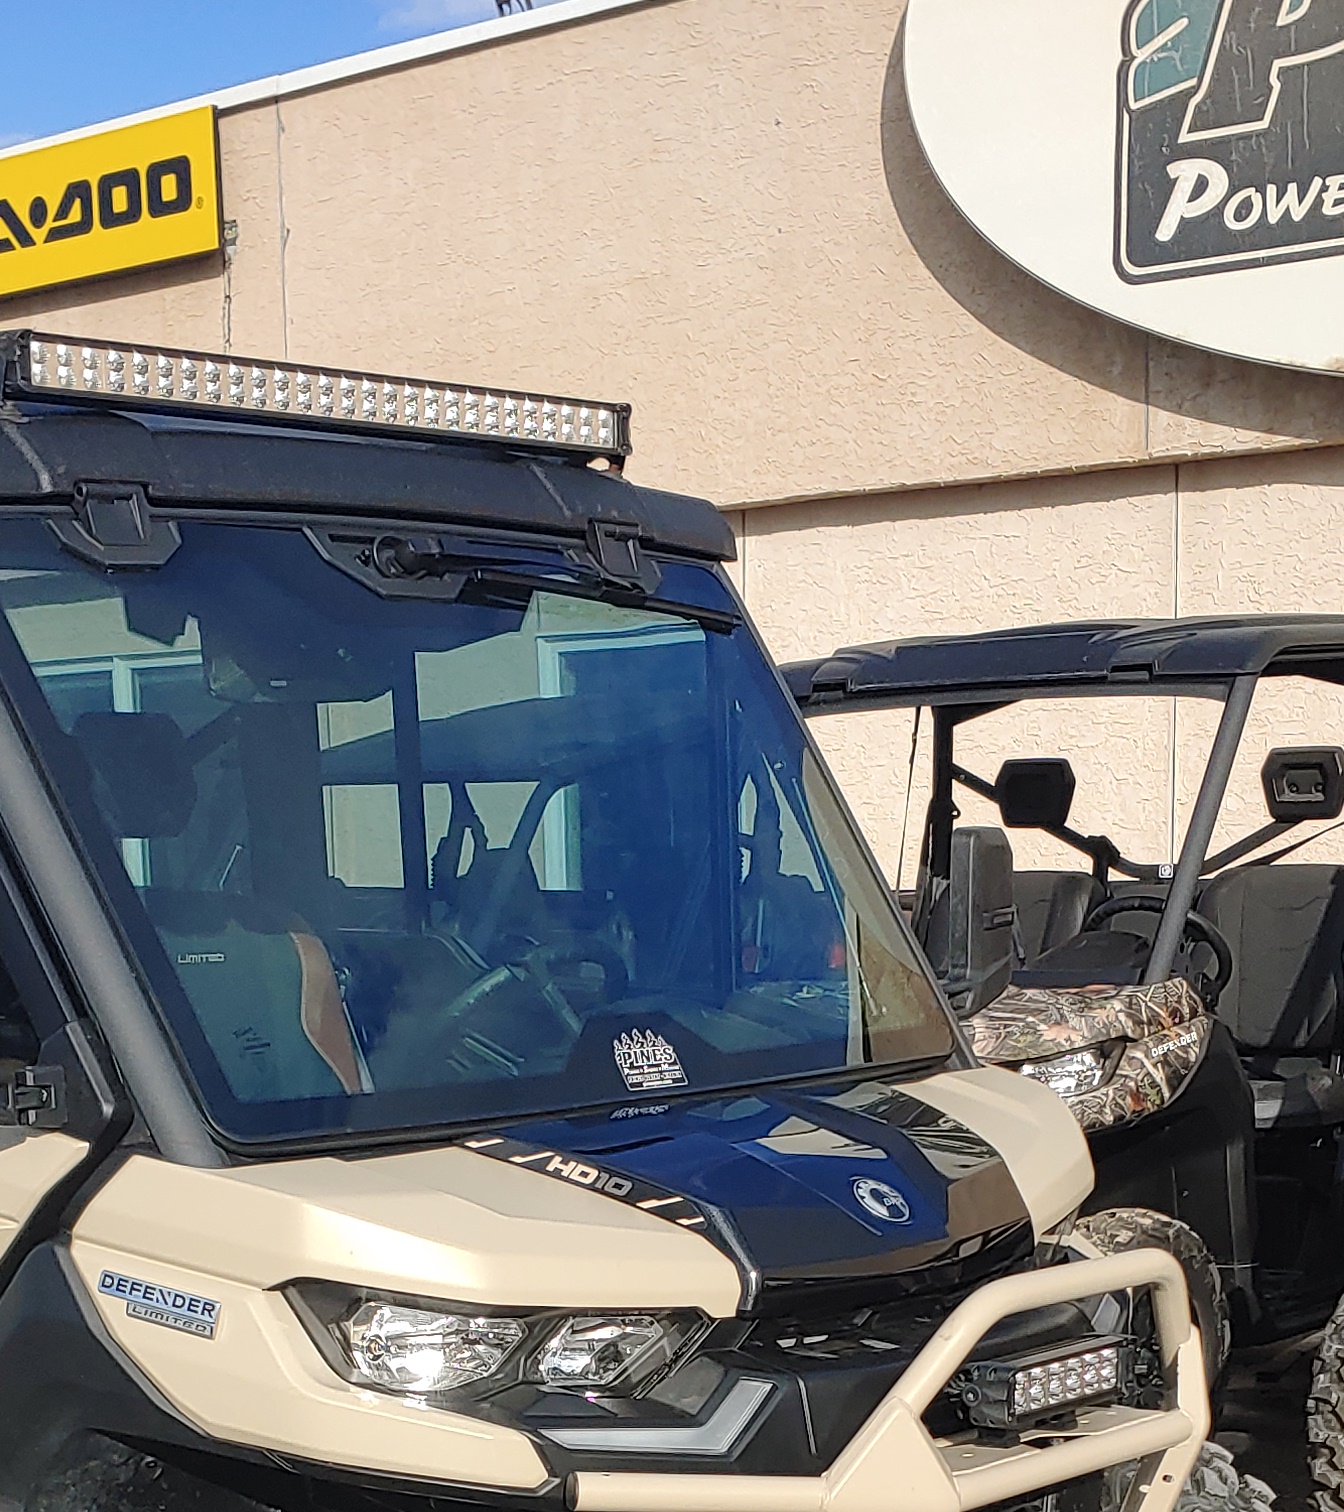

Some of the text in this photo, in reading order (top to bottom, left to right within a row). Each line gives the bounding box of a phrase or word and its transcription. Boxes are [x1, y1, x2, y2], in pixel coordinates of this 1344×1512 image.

[621, 1046, 674, 1068] PINES
[1151, 1031, 1198, 1057] DEFENDER
[545, 1154, 634, 1197] HD10
[100, 1273, 218, 1319] DEFENDER
[130, 1303, 208, 1334] LIMITED
